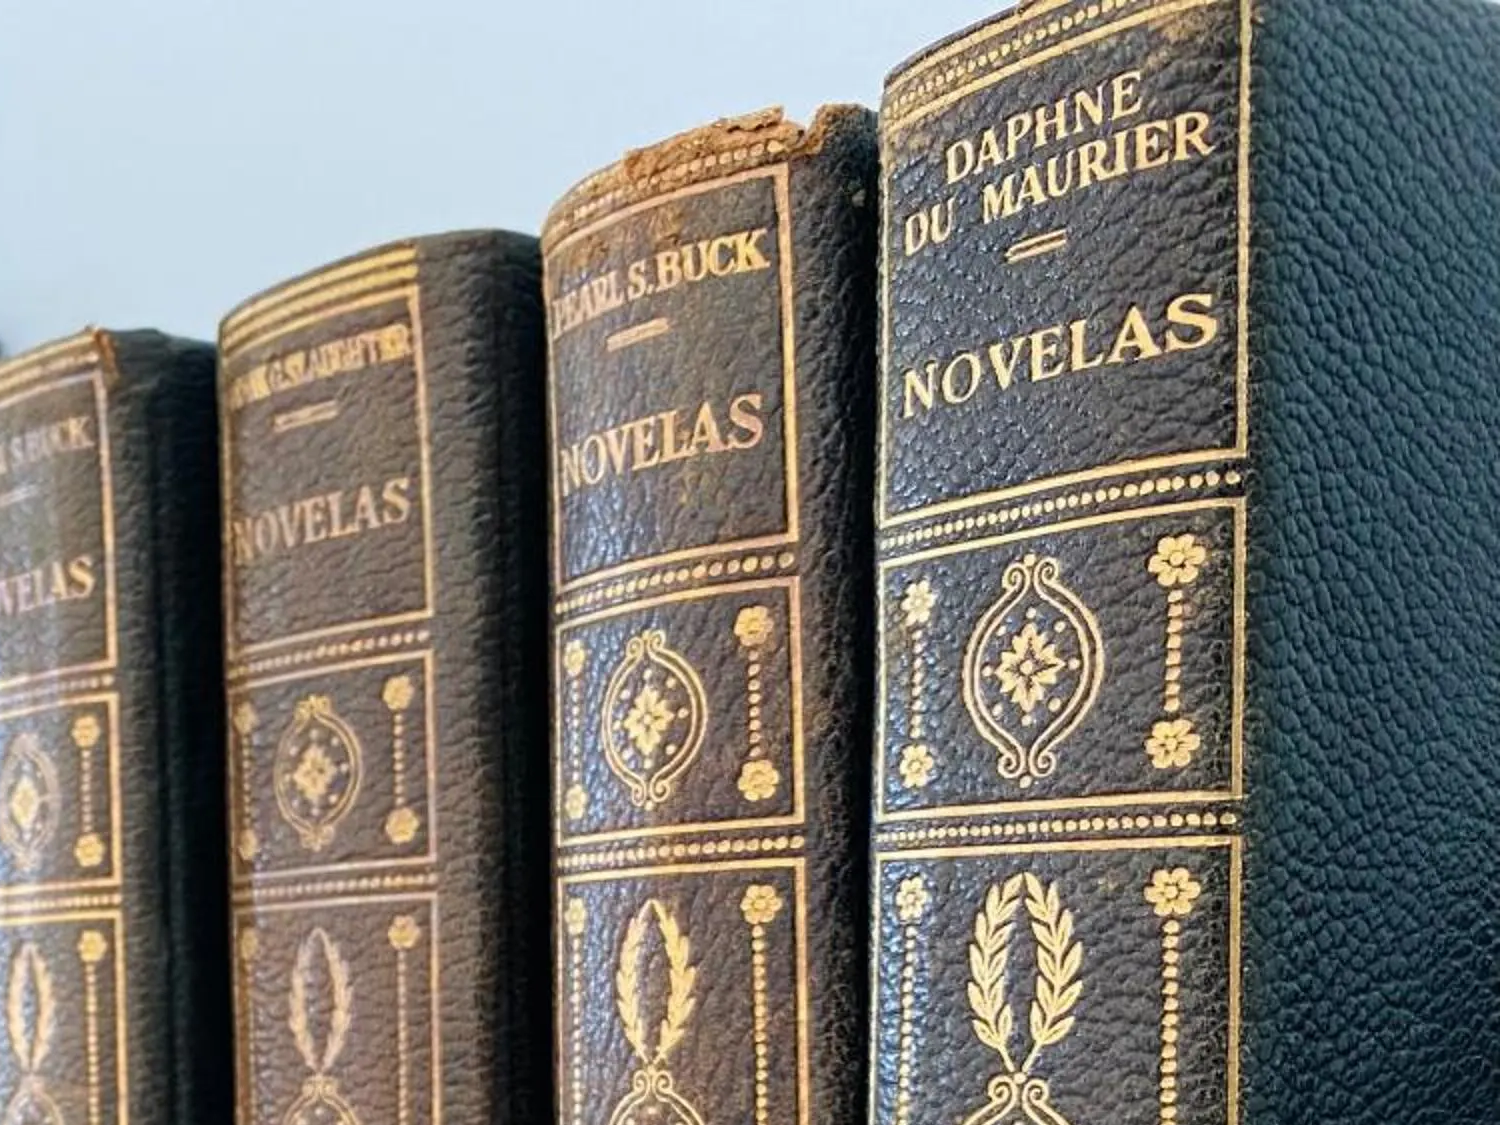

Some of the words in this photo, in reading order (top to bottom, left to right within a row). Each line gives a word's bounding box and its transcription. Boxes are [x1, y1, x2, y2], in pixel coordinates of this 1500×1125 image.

[904, 196, 956, 257] DU
[981, 111, 1216, 225] MAURIER
[945, 70, 1142, 184] DAPHNE
[902, 293, 1218, 419] NOVELAS
[560, 393, 764, 498] NOVELAS
[233, 476, 411, 566] NOVELAS
